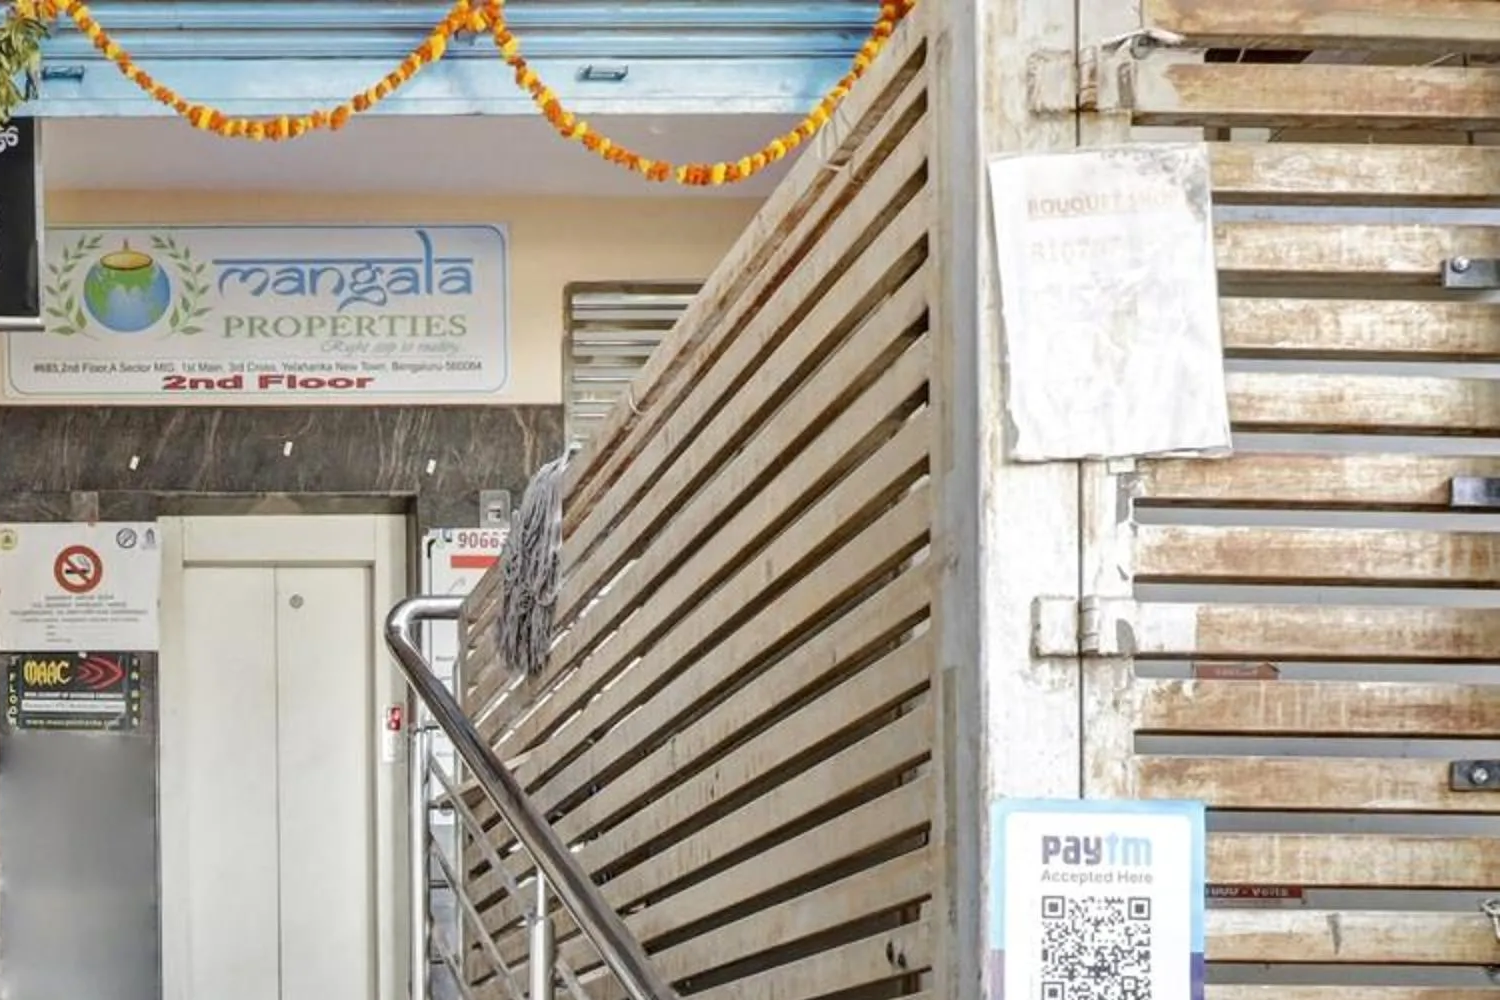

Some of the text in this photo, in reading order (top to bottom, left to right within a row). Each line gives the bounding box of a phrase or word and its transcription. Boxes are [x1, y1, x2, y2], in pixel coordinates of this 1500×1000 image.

[212, 229, 474, 312] mangala
[222, 314, 468, 338] PROPERTIES
[162, 374, 376, 390] 2nd Floor
[1040, 869, 1153, 886] Accepted Here
